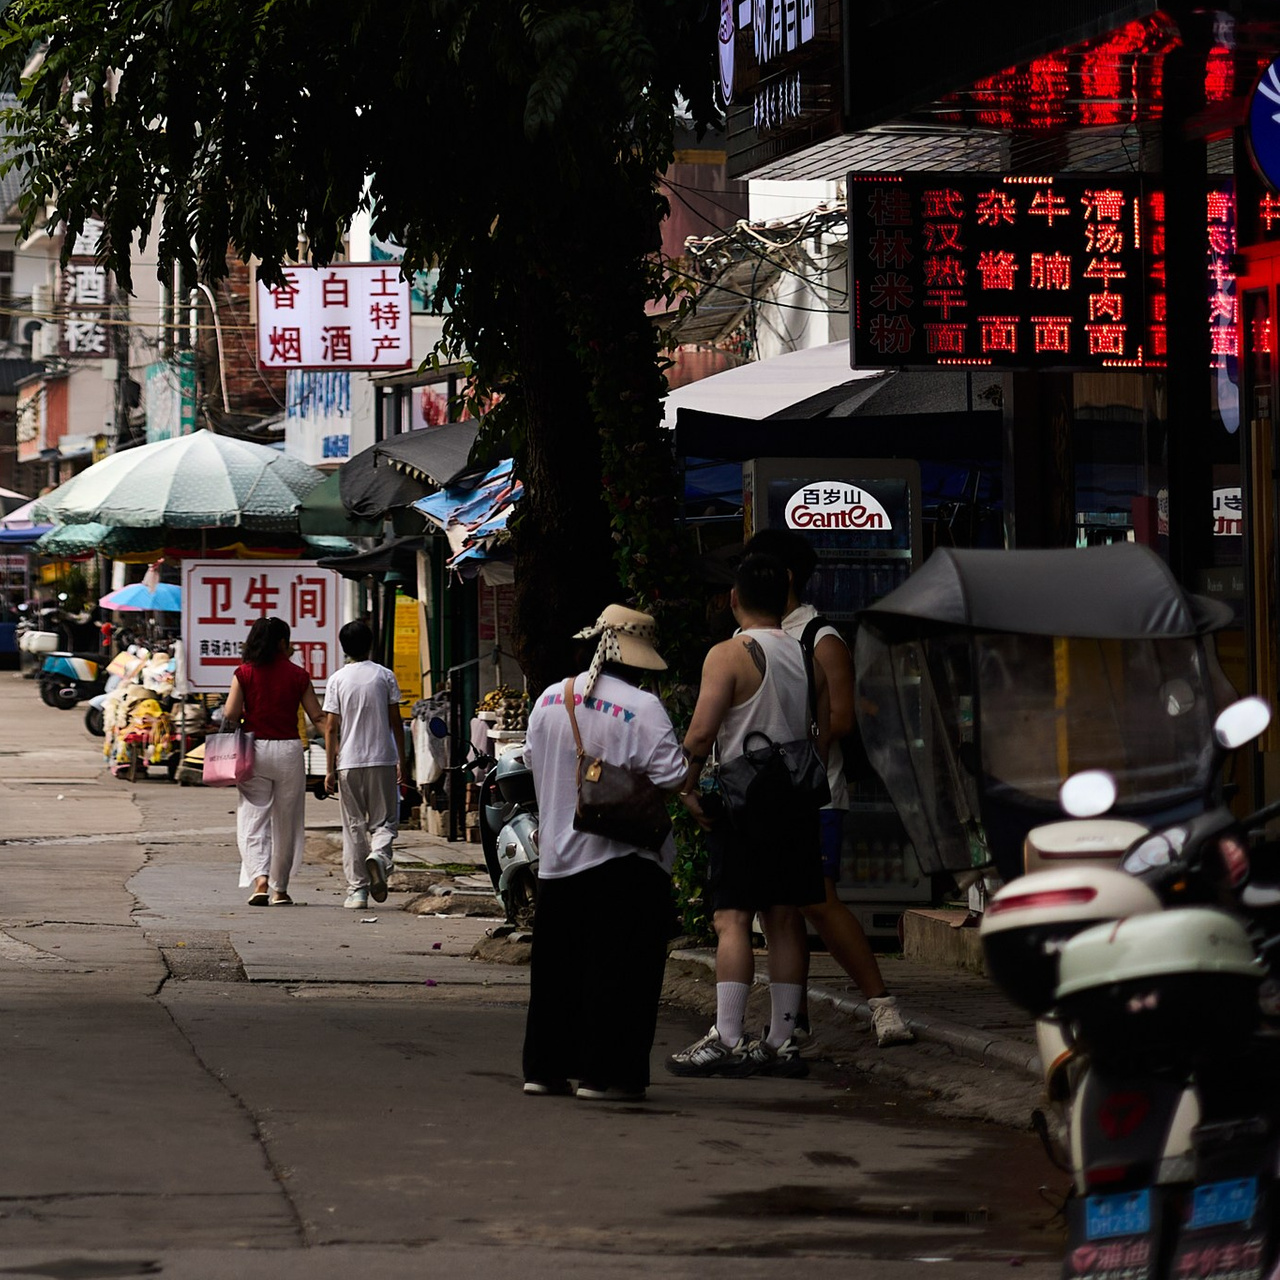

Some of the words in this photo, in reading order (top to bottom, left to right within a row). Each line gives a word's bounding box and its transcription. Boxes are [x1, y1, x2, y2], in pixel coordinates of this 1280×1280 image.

[370, 269, 401, 363] 土特产
[868, 187, 916, 355] 桂林米粉
[922, 187, 968, 354] 武汉热干面
[976, 188, 1021, 354] 杂酱面
[1027, 188, 1072, 354] 牛腩面
[1081, 188, 1127, 355] 清汤牛肉面
[269, 272, 302, 363] 香烟
[321, 272, 353, 362] 白酒
[791, 505, 883, 528] Ganten
[803, 489, 861, 505] 百岁山
[198, 574, 326, 628] 卫生间
[584, 696, 636, 723] KITTY
